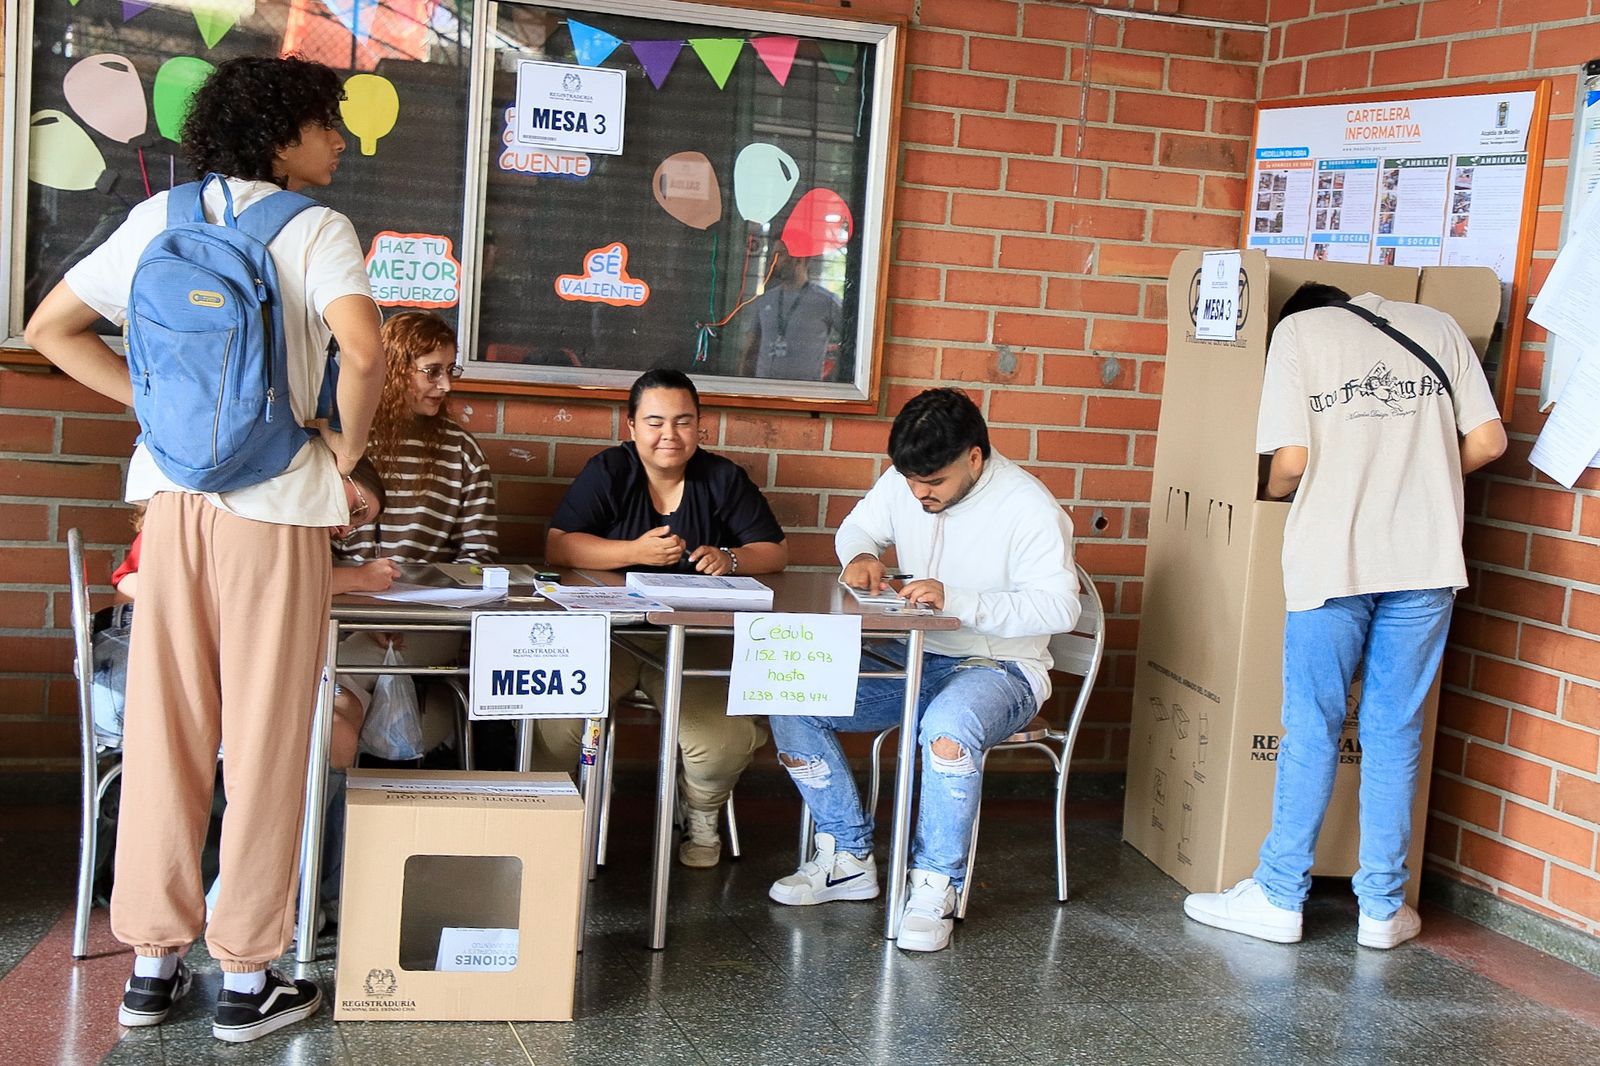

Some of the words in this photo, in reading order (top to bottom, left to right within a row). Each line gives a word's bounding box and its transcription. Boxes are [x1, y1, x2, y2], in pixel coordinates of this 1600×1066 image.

[532, 107, 589, 133] MESA
[593, 114, 606, 135] 3
[1346, 106, 1411, 123] CARTELERA
[1344, 123, 1421, 141] INFORMATIVA
[501, 152, 588, 175] CUENTE
[1405, 158, 1447, 167] AMBIENTAL
[1480, 156, 1526, 164] AMBIENTAL
[1339, 234, 1368, 242] SOCIAL
[1407, 237, 1439, 245] SOCIAL
[379, 240, 415, 254] HAZ
[422, 241, 445, 256] TU
[590, 247, 620, 275] SÉ
[368, 259, 456, 281] MEJOR
[562, 279, 643, 300] VALIENTE
[1203, 299, 1225, 320] MESA
[1225, 299, 1232, 321] 3
[491, 669, 564, 696] MESA
[570, 669, 587, 695] 3
[767, 668, 805, 682] hasta
[455, 955, 517, 966] CCIONES
